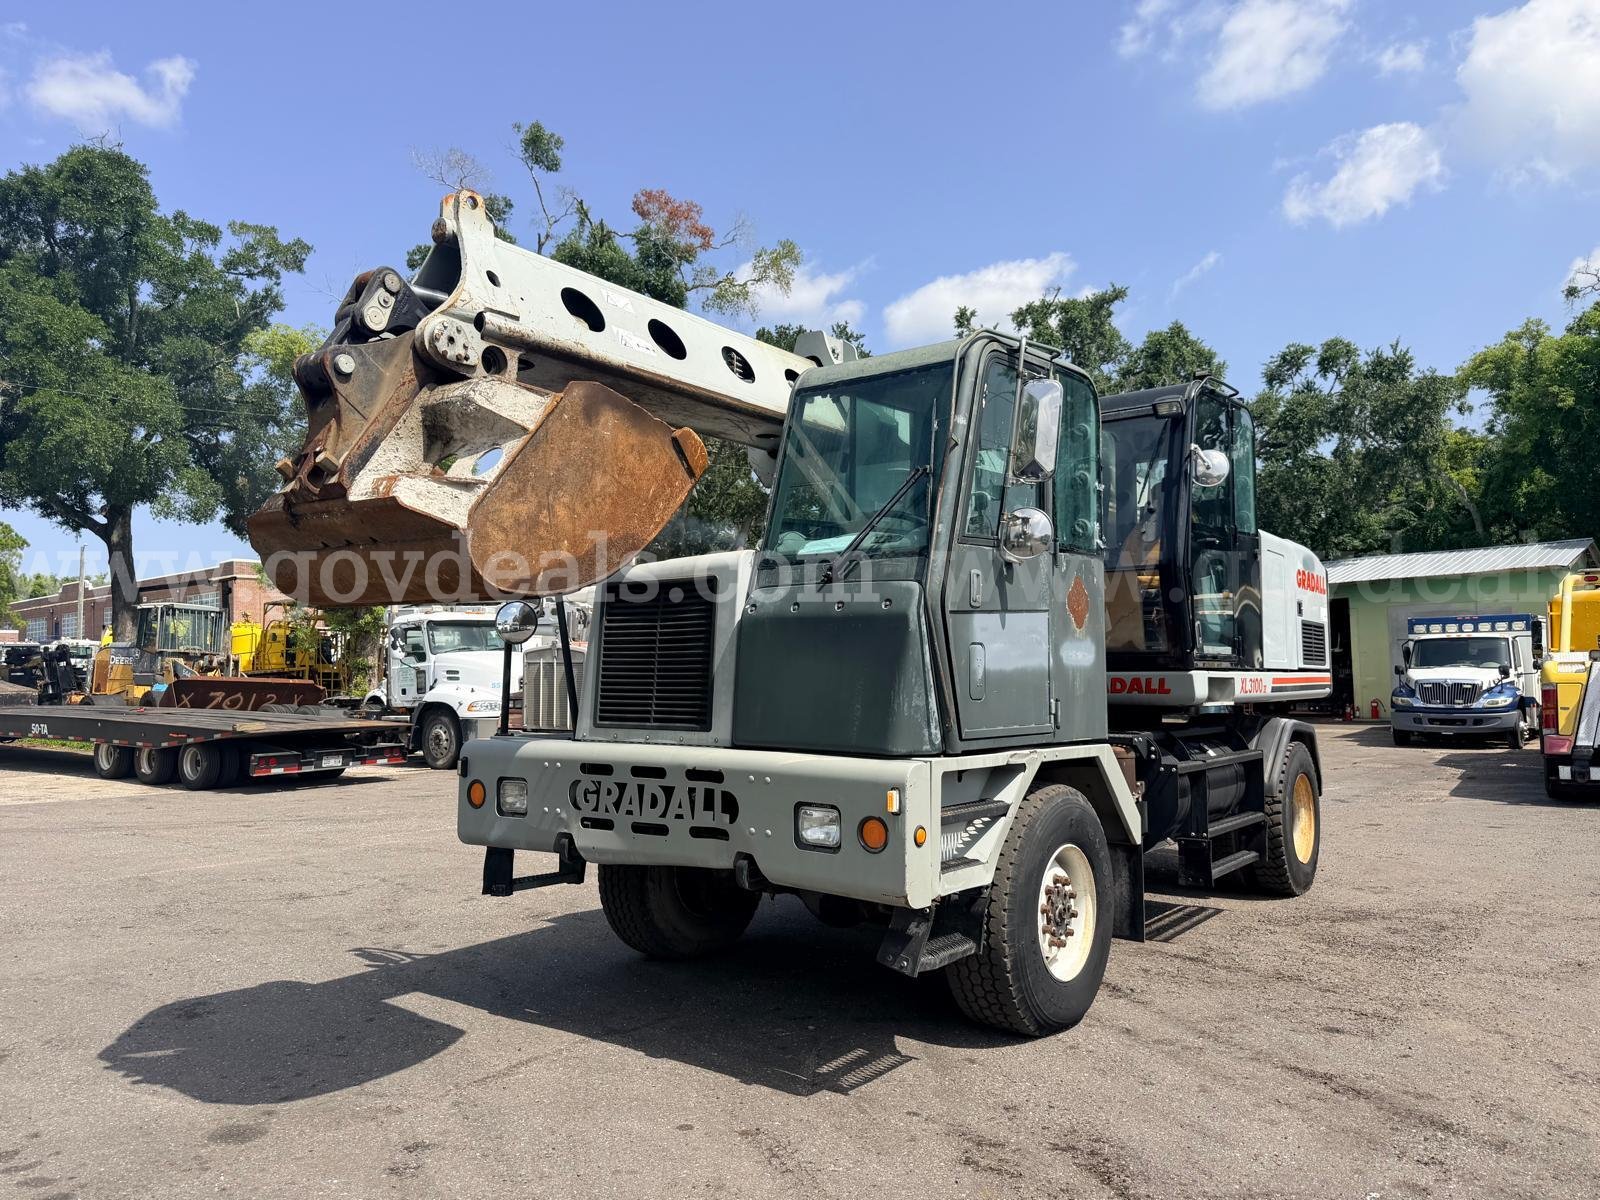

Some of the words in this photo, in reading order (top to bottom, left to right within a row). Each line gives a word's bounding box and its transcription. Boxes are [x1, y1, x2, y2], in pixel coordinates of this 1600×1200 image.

[1296, 568, 1326, 595] GRADALL
[110, 655, 134, 665] DEERE
[1107, 677, 1172, 695] DALL
[574, 778, 731, 825] GRADALL
